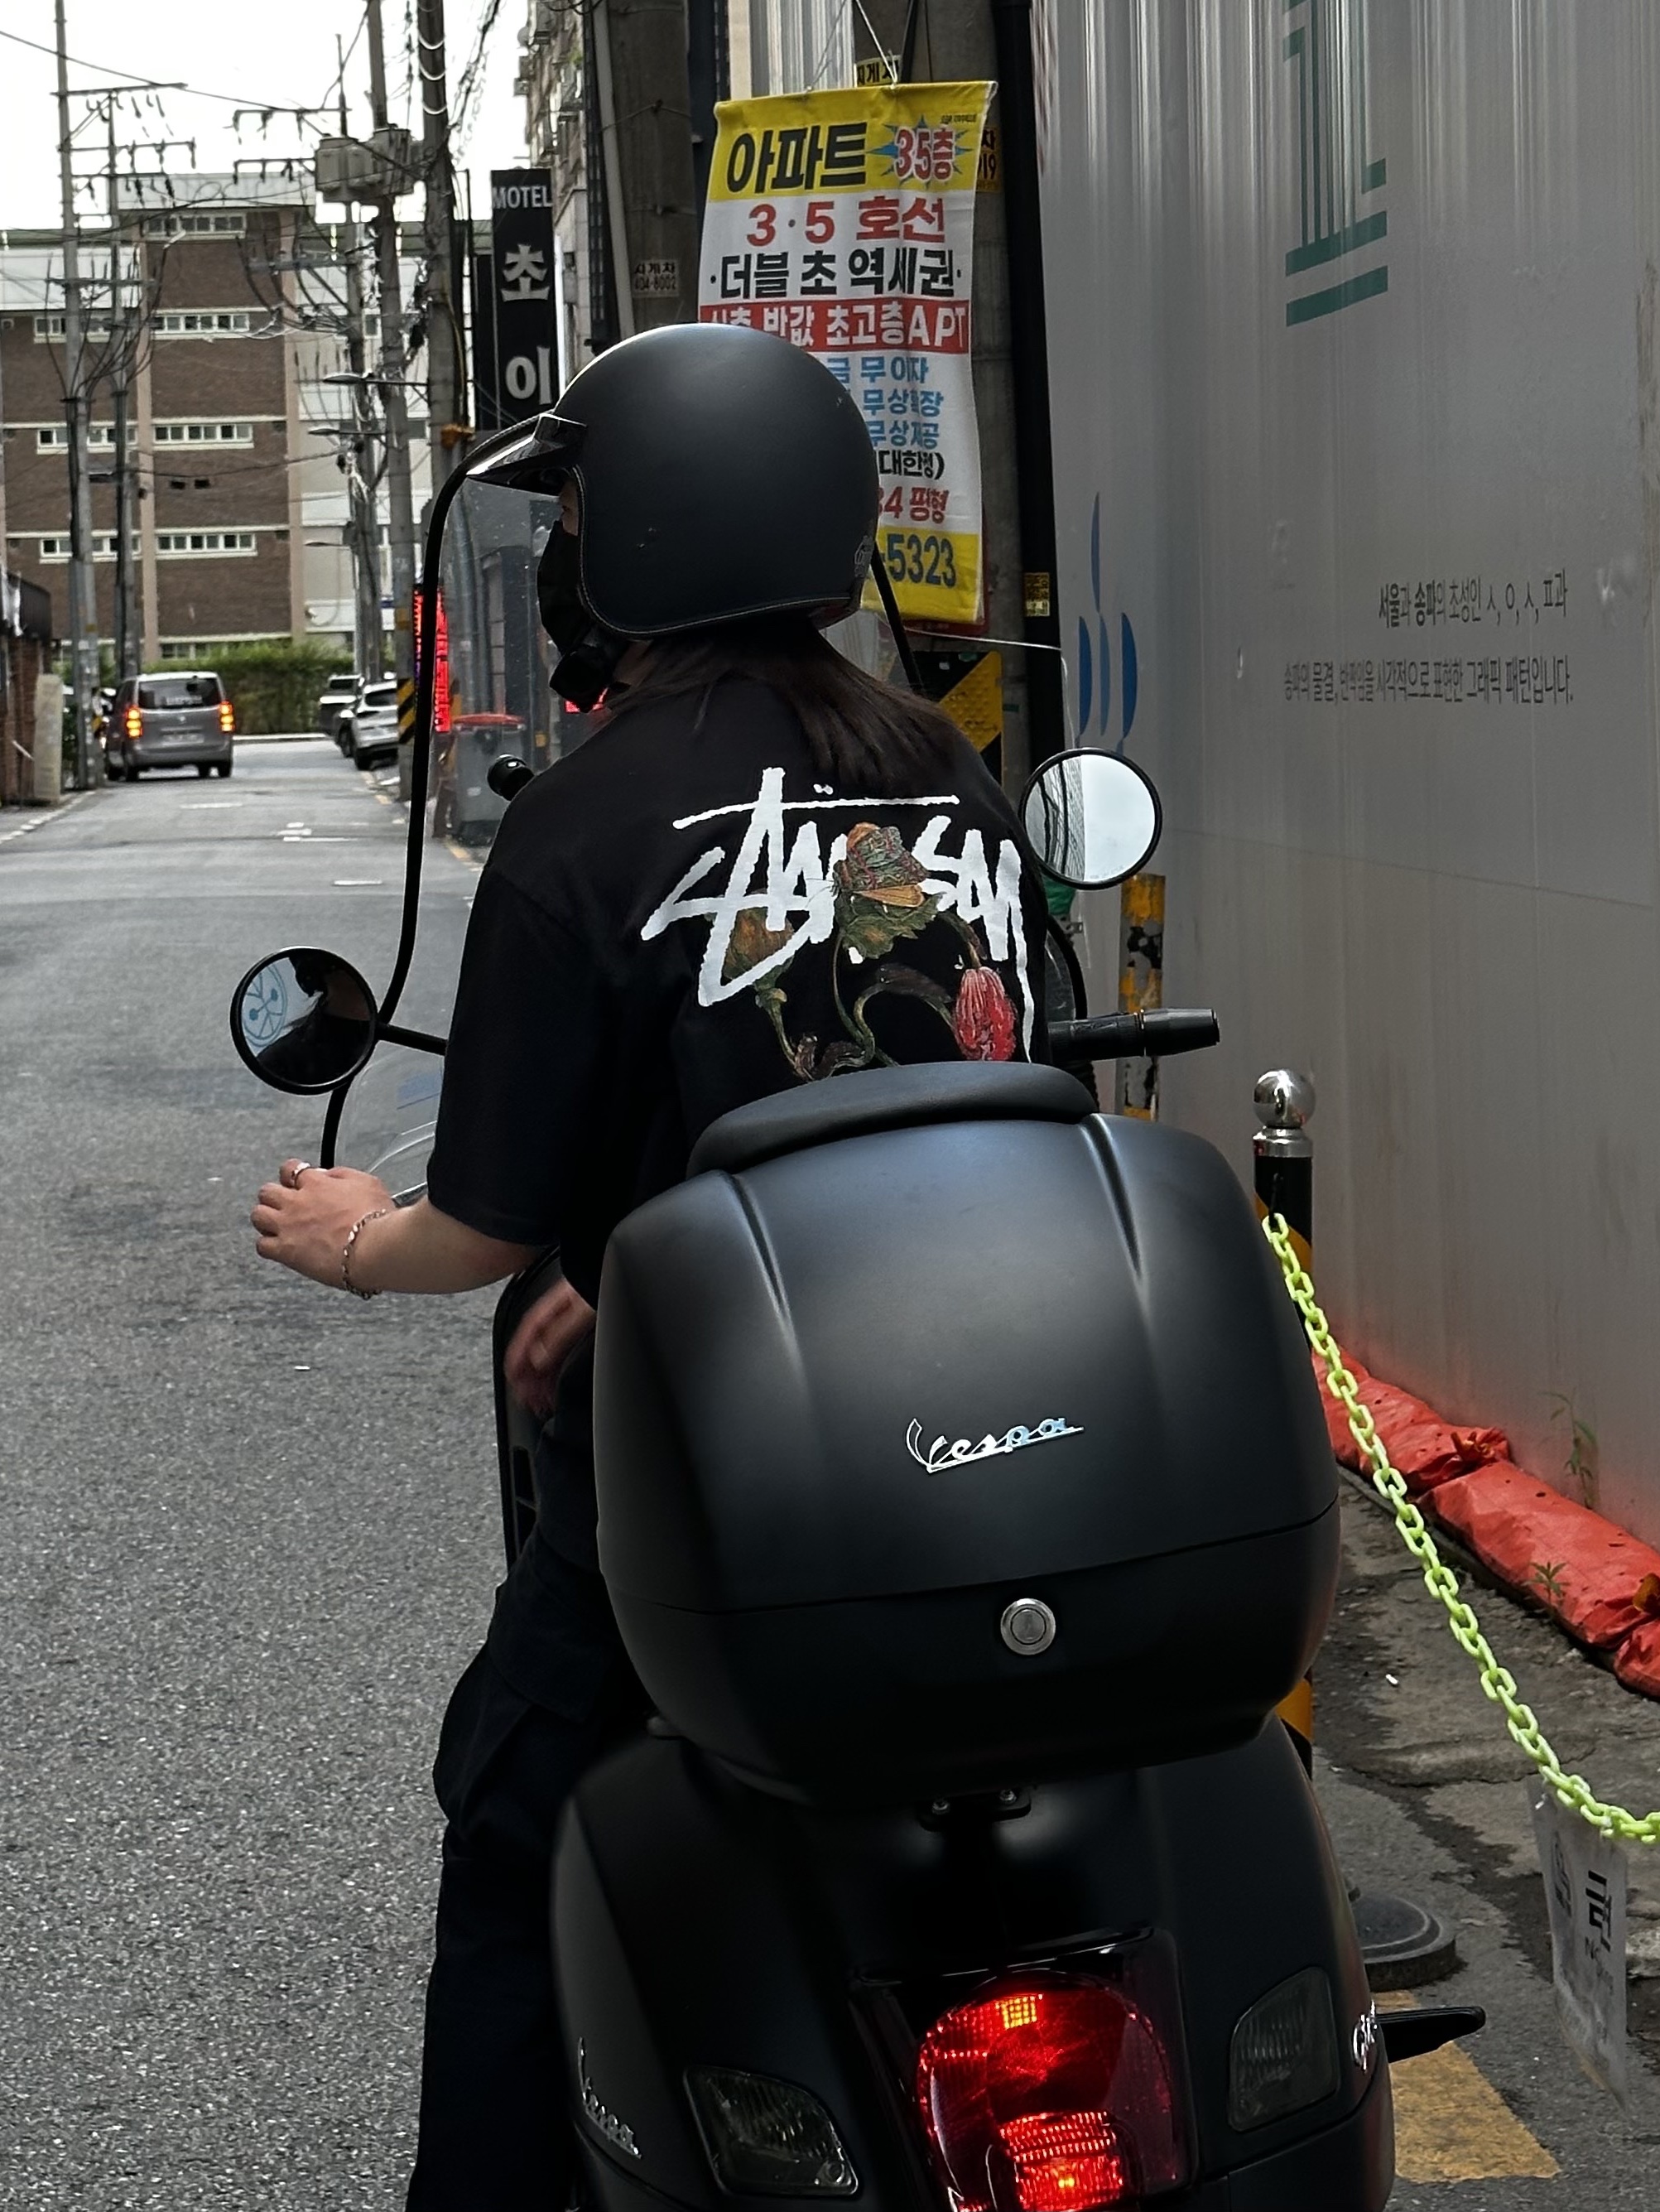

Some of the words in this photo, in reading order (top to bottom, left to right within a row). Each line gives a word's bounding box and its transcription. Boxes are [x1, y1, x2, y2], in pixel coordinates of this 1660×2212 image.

[727, 122, 868, 194] 아파트
[894, 126, 955, 181] 35층
[492, 186, 553, 209] MOTEL
[856, 195, 945, 243] 호선
[860, 356, 929, 383] 무이자
[909, 487, 950, 523] 평형
[1379, 581, 1411, 628] 서울과
[1415, 579, 1446, 626] 송파의
[1449, 576, 1481, 623] 초성인
[1376, 659, 1432, 701] 시각적으로
[1433, 660, 1463, 702] 표현한
[1466, 658, 1501, 704] 그래픽
[1505, 655, 1573, 704] 패턴입니다.
[907, 1418, 1084, 1473] Vespa
